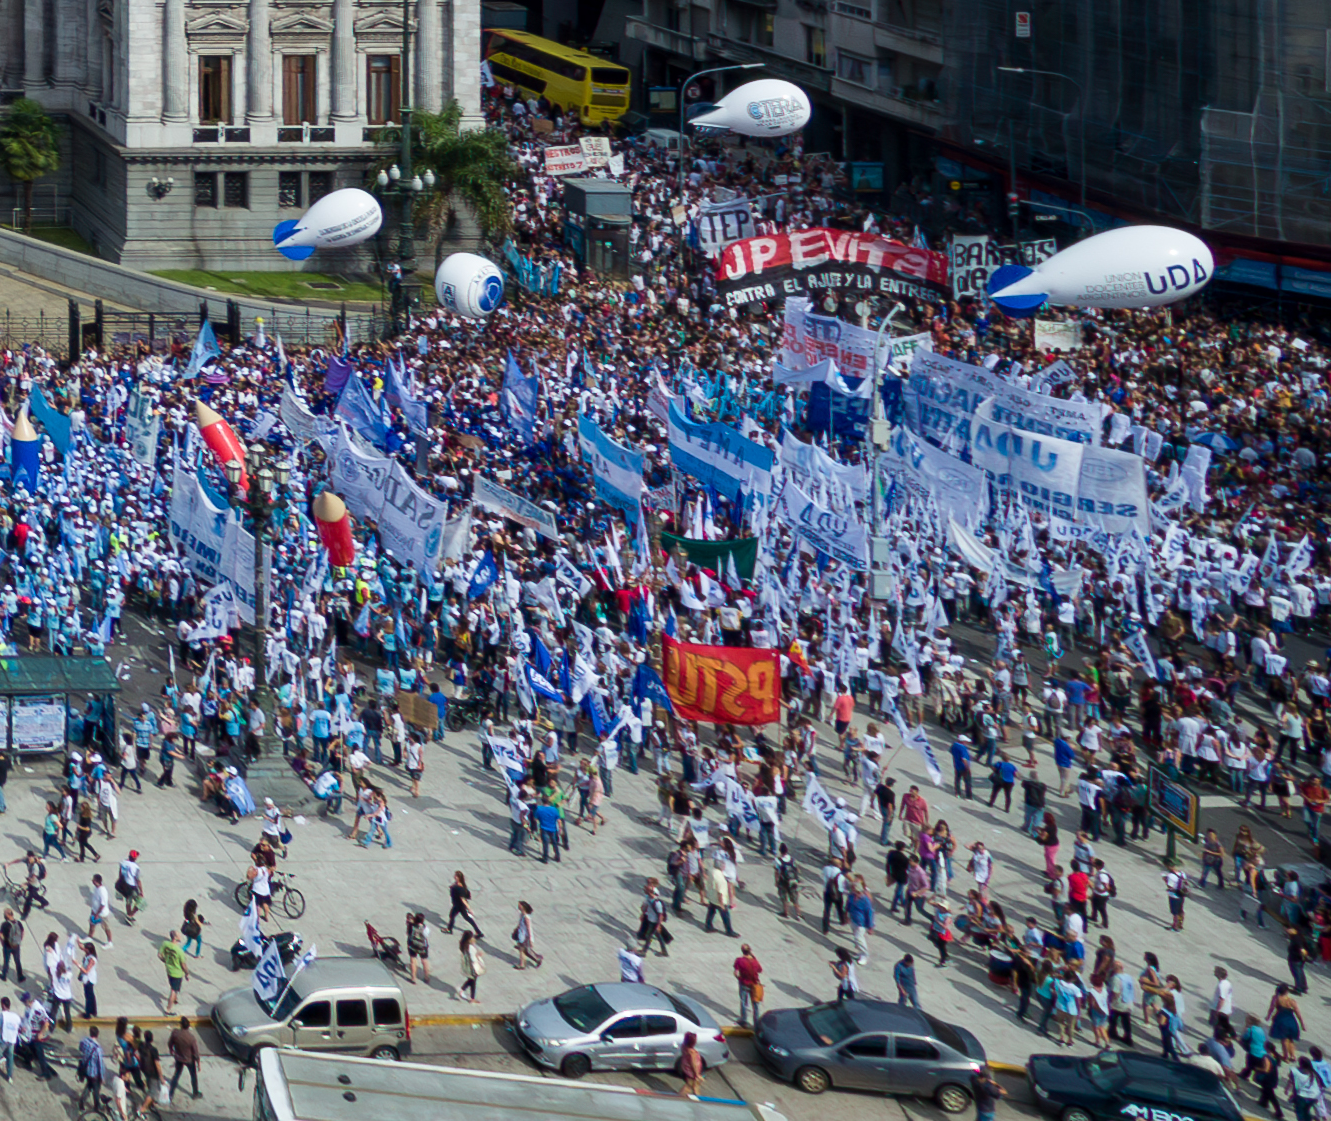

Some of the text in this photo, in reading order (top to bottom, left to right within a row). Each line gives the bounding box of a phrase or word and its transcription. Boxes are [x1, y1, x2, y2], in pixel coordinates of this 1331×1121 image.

[726, 238, 777, 280] JP
[1085, 281, 1145, 294] DOCENTES
[1104, 272, 1142, 283] UNION
[1144, 258, 1207, 295] UDA
[726, 283, 776, 306] CONTRA
[784, 277, 803, 293] EL
[857, 275, 872, 289] LA
[1121, 1103, 1150, 1121] AM
